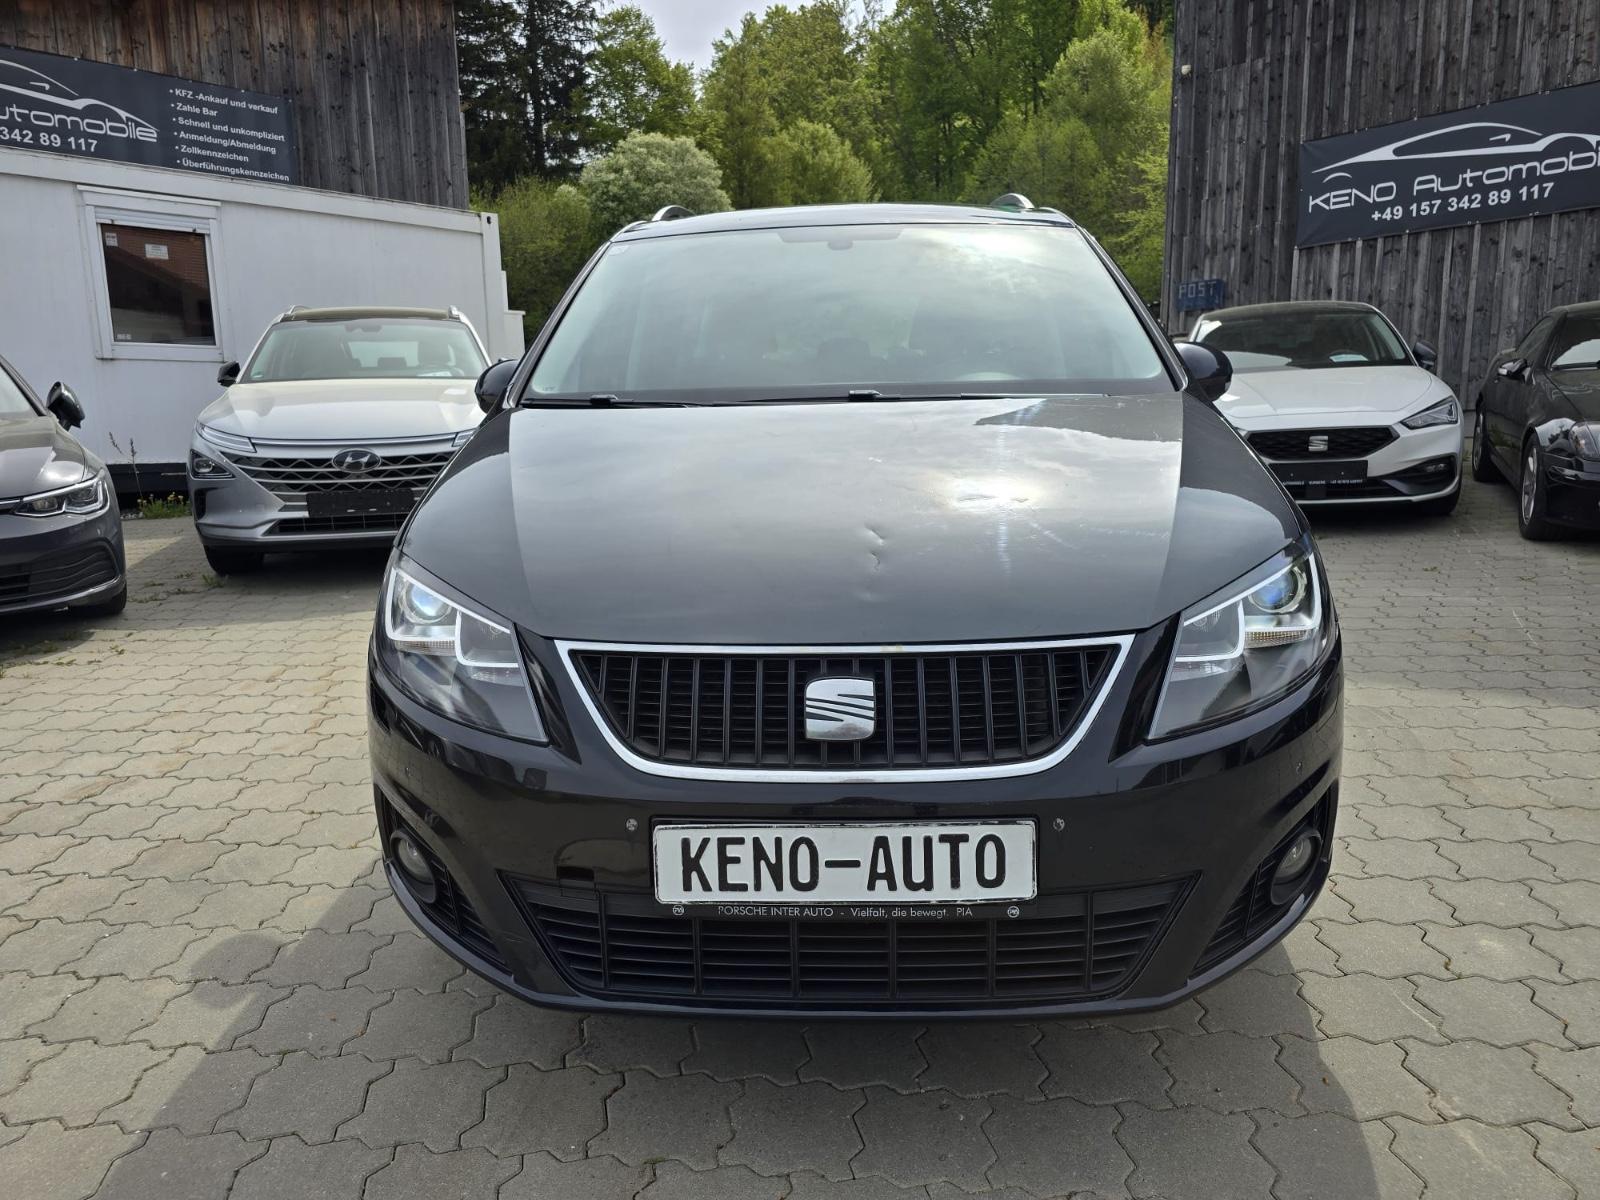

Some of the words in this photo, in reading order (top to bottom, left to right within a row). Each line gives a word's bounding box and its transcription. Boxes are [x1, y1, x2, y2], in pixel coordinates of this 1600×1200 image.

[175, 88, 193, 99] KFZ
[229, 99, 246, 108] und
[247, 102, 278, 114] verkauf
[176, 102, 200, 114] Zahle
[202, 107, 218, 117] Bar
[0, 126, 34, 144] 342
[39, 132, 61, 148] 89
[67, 136, 98, 152] 117
[178, 116, 210, 129] Schnell
[212, 124, 229, 132] und
[230, 127, 285, 142] unkompliziert
[180, 144, 249, 162] Zollkennzeichen
[182, 157, 290, 182] Überführungskennzeichen
[1308, 181, 1397, 213] KENO
[1371, 204, 1403, 222] +49
[1409, 199, 1441, 218] 157
[1447, 192, 1481, 212] 342
[1488, 188, 1511, 206] 89
[1518, 182, 1555, 201] 117
[1178, 280, 1217, 299] POST
[718, 906, 768, 916] PORSCHE
[771, 907, 801, 917] INTER
[803, 907, 834, 917] AUTO
[850, 907, 889, 919] Vielfalt,
[891, 907, 907, 917] die
[956, 907, 973, 917] PIA
